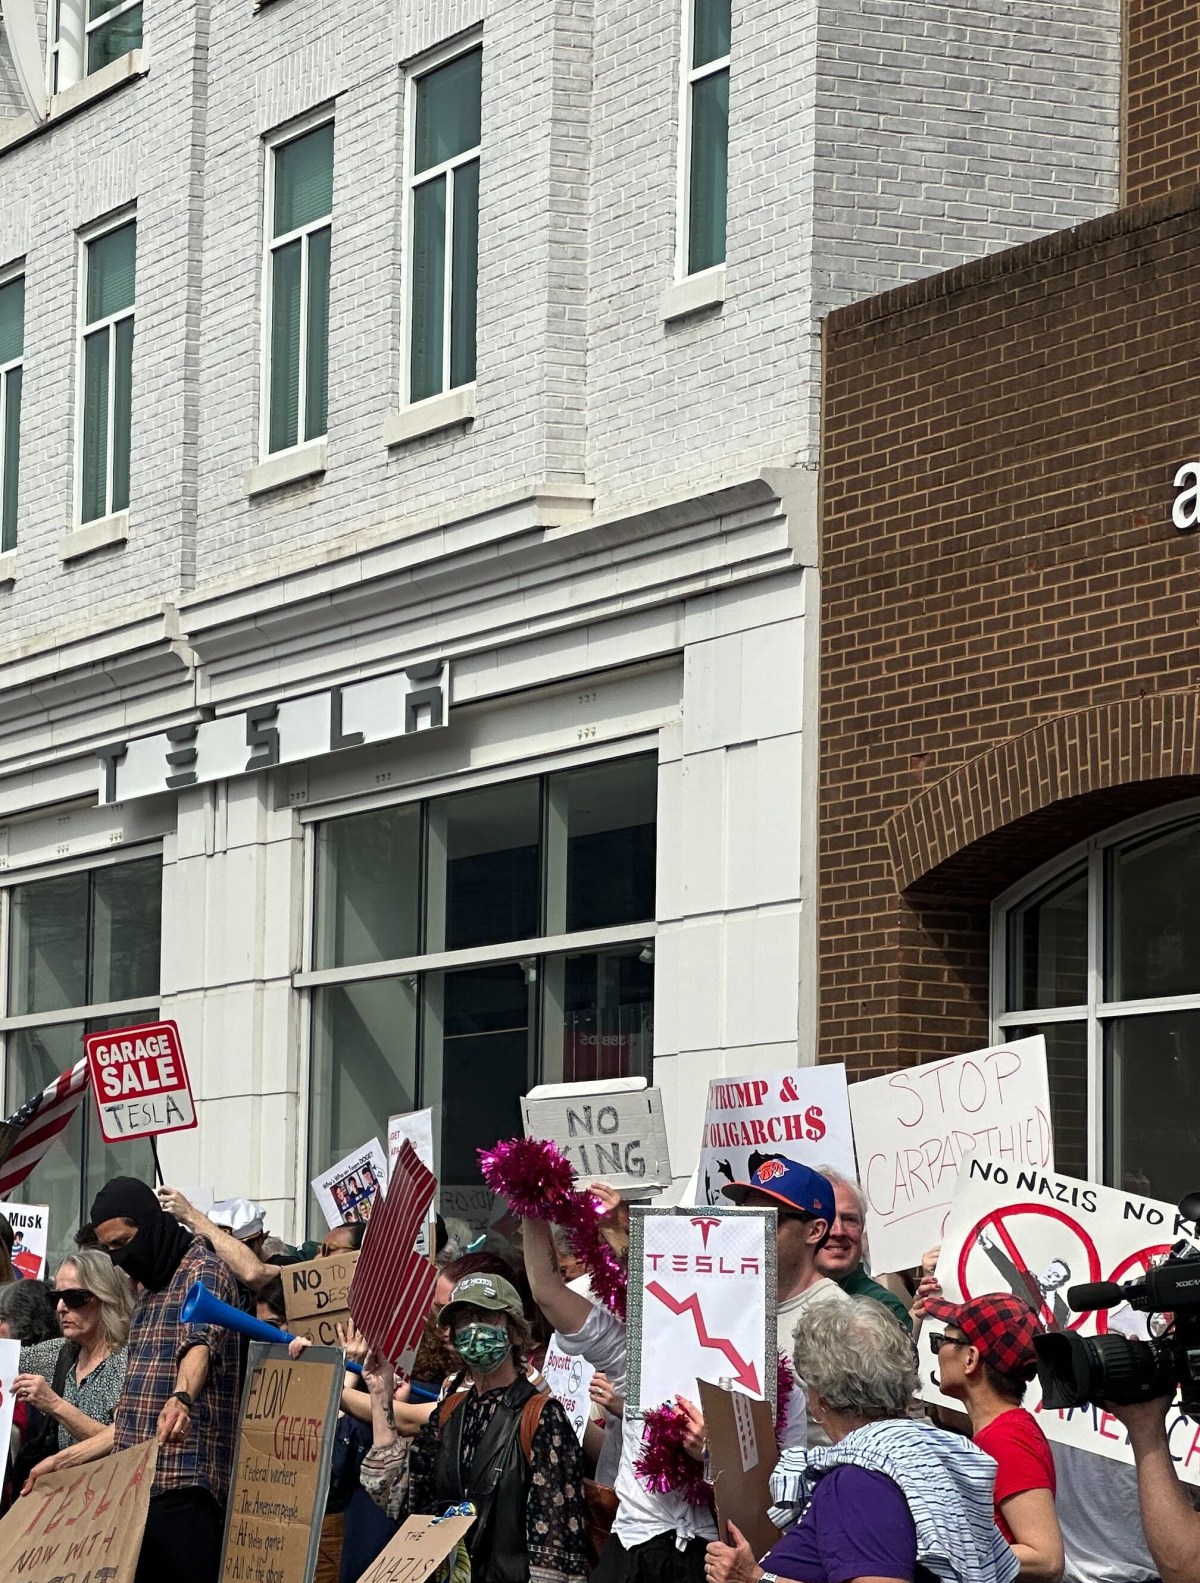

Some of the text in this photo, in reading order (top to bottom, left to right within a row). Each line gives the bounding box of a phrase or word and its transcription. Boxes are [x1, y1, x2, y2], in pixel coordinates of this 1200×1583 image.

[97, 659, 444, 804] TESLA
[96, 1034, 172, 1067] GARAGE
[101, 1056, 179, 1097] SALE
[715, 1080, 769, 1110] TRUMP
[779, 1075, 800, 1103] &
[888, 1051, 1022, 1127] STOP
[104, 1094, 185, 1133] TESLA
[566, 1105, 619, 1137] NO
[710, 1105, 827, 1149] OLIGARCH$
[358, 1151, 375, 1164] DOGE?
[969, 1159, 1008, 1185] NO
[1016, 1171, 1098, 1213] NAZIS
[1123, 1201, 1164, 1226] NO
[8, 1212, 43, 1229] Musk
[292, 1264, 347, 1294] NO TO
[646, 1254, 759, 1275] TESLA
[548, 1350, 571, 1371] Boycott
[245, 1368, 293, 1420] ELON
[273, 1414, 322, 1462] CHEATS
[24, 1440, 155, 1536] TESLA
[244, 1457, 298, 1488] Federal workers
[241, 1489, 298, 1526] The American people
[10, 1543, 59, 1574] NOW
[64, 1527, 117, 1565] WITH
[236, 1520, 285, 1563] At video games
[403, 1530, 426, 1542] THE
[232, 1556, 245, 1580] All
[245, 1554, 254, 1579] of
[255, 1556, 265, 1583] the
[362, 1556, 435, 1583] NAZIS
